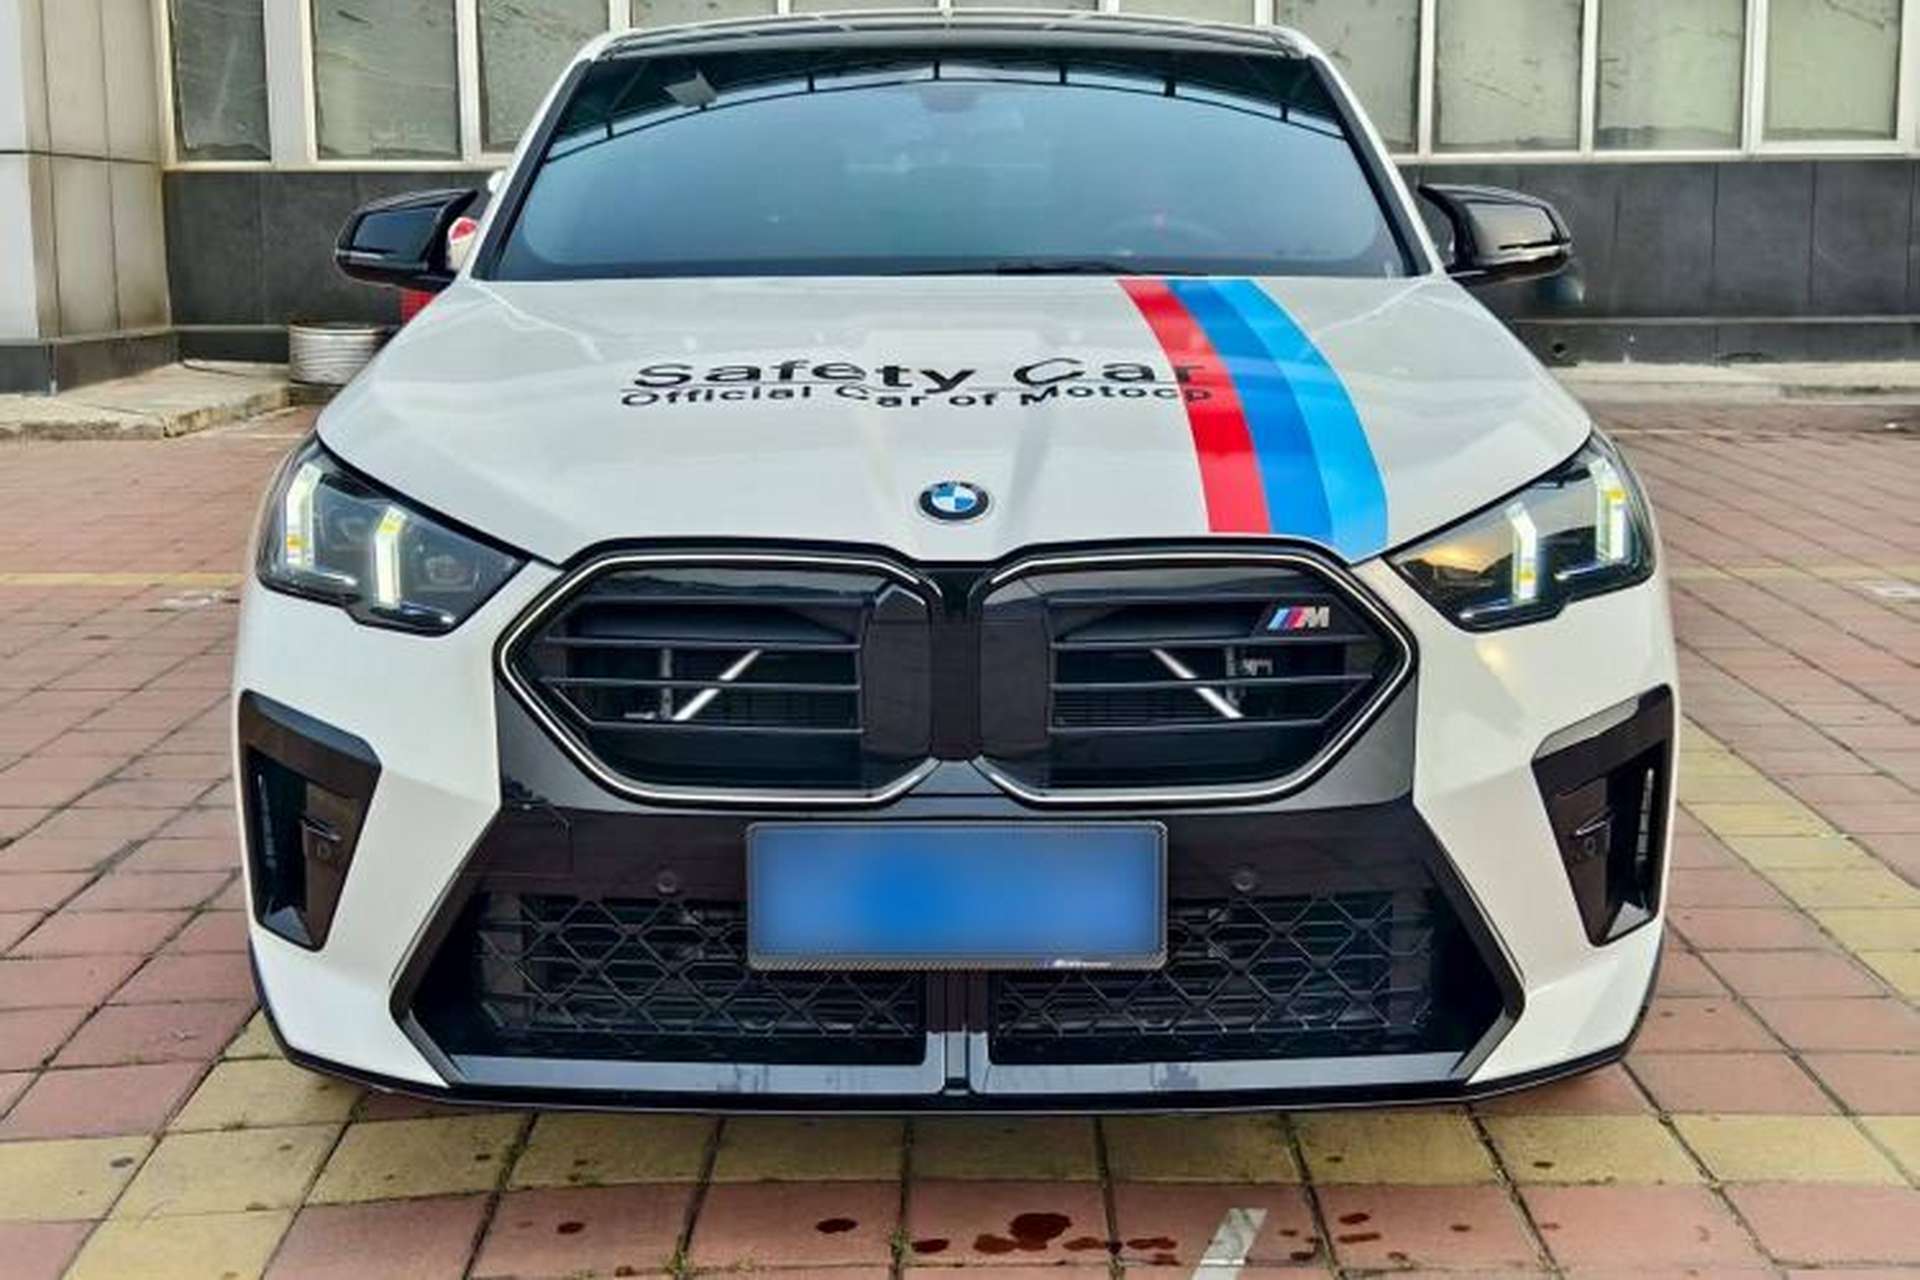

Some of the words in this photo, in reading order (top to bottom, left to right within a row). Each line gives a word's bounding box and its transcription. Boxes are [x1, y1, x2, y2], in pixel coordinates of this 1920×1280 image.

[634, 360, 977, 394] Safety
[1013, 358, 1205, 384] Car
[621, 386, 811, 406] Official
[835, 385, 927, 407] Car
[948, 392, 997, 406] of
[1290, 606, 1330, 629] M
